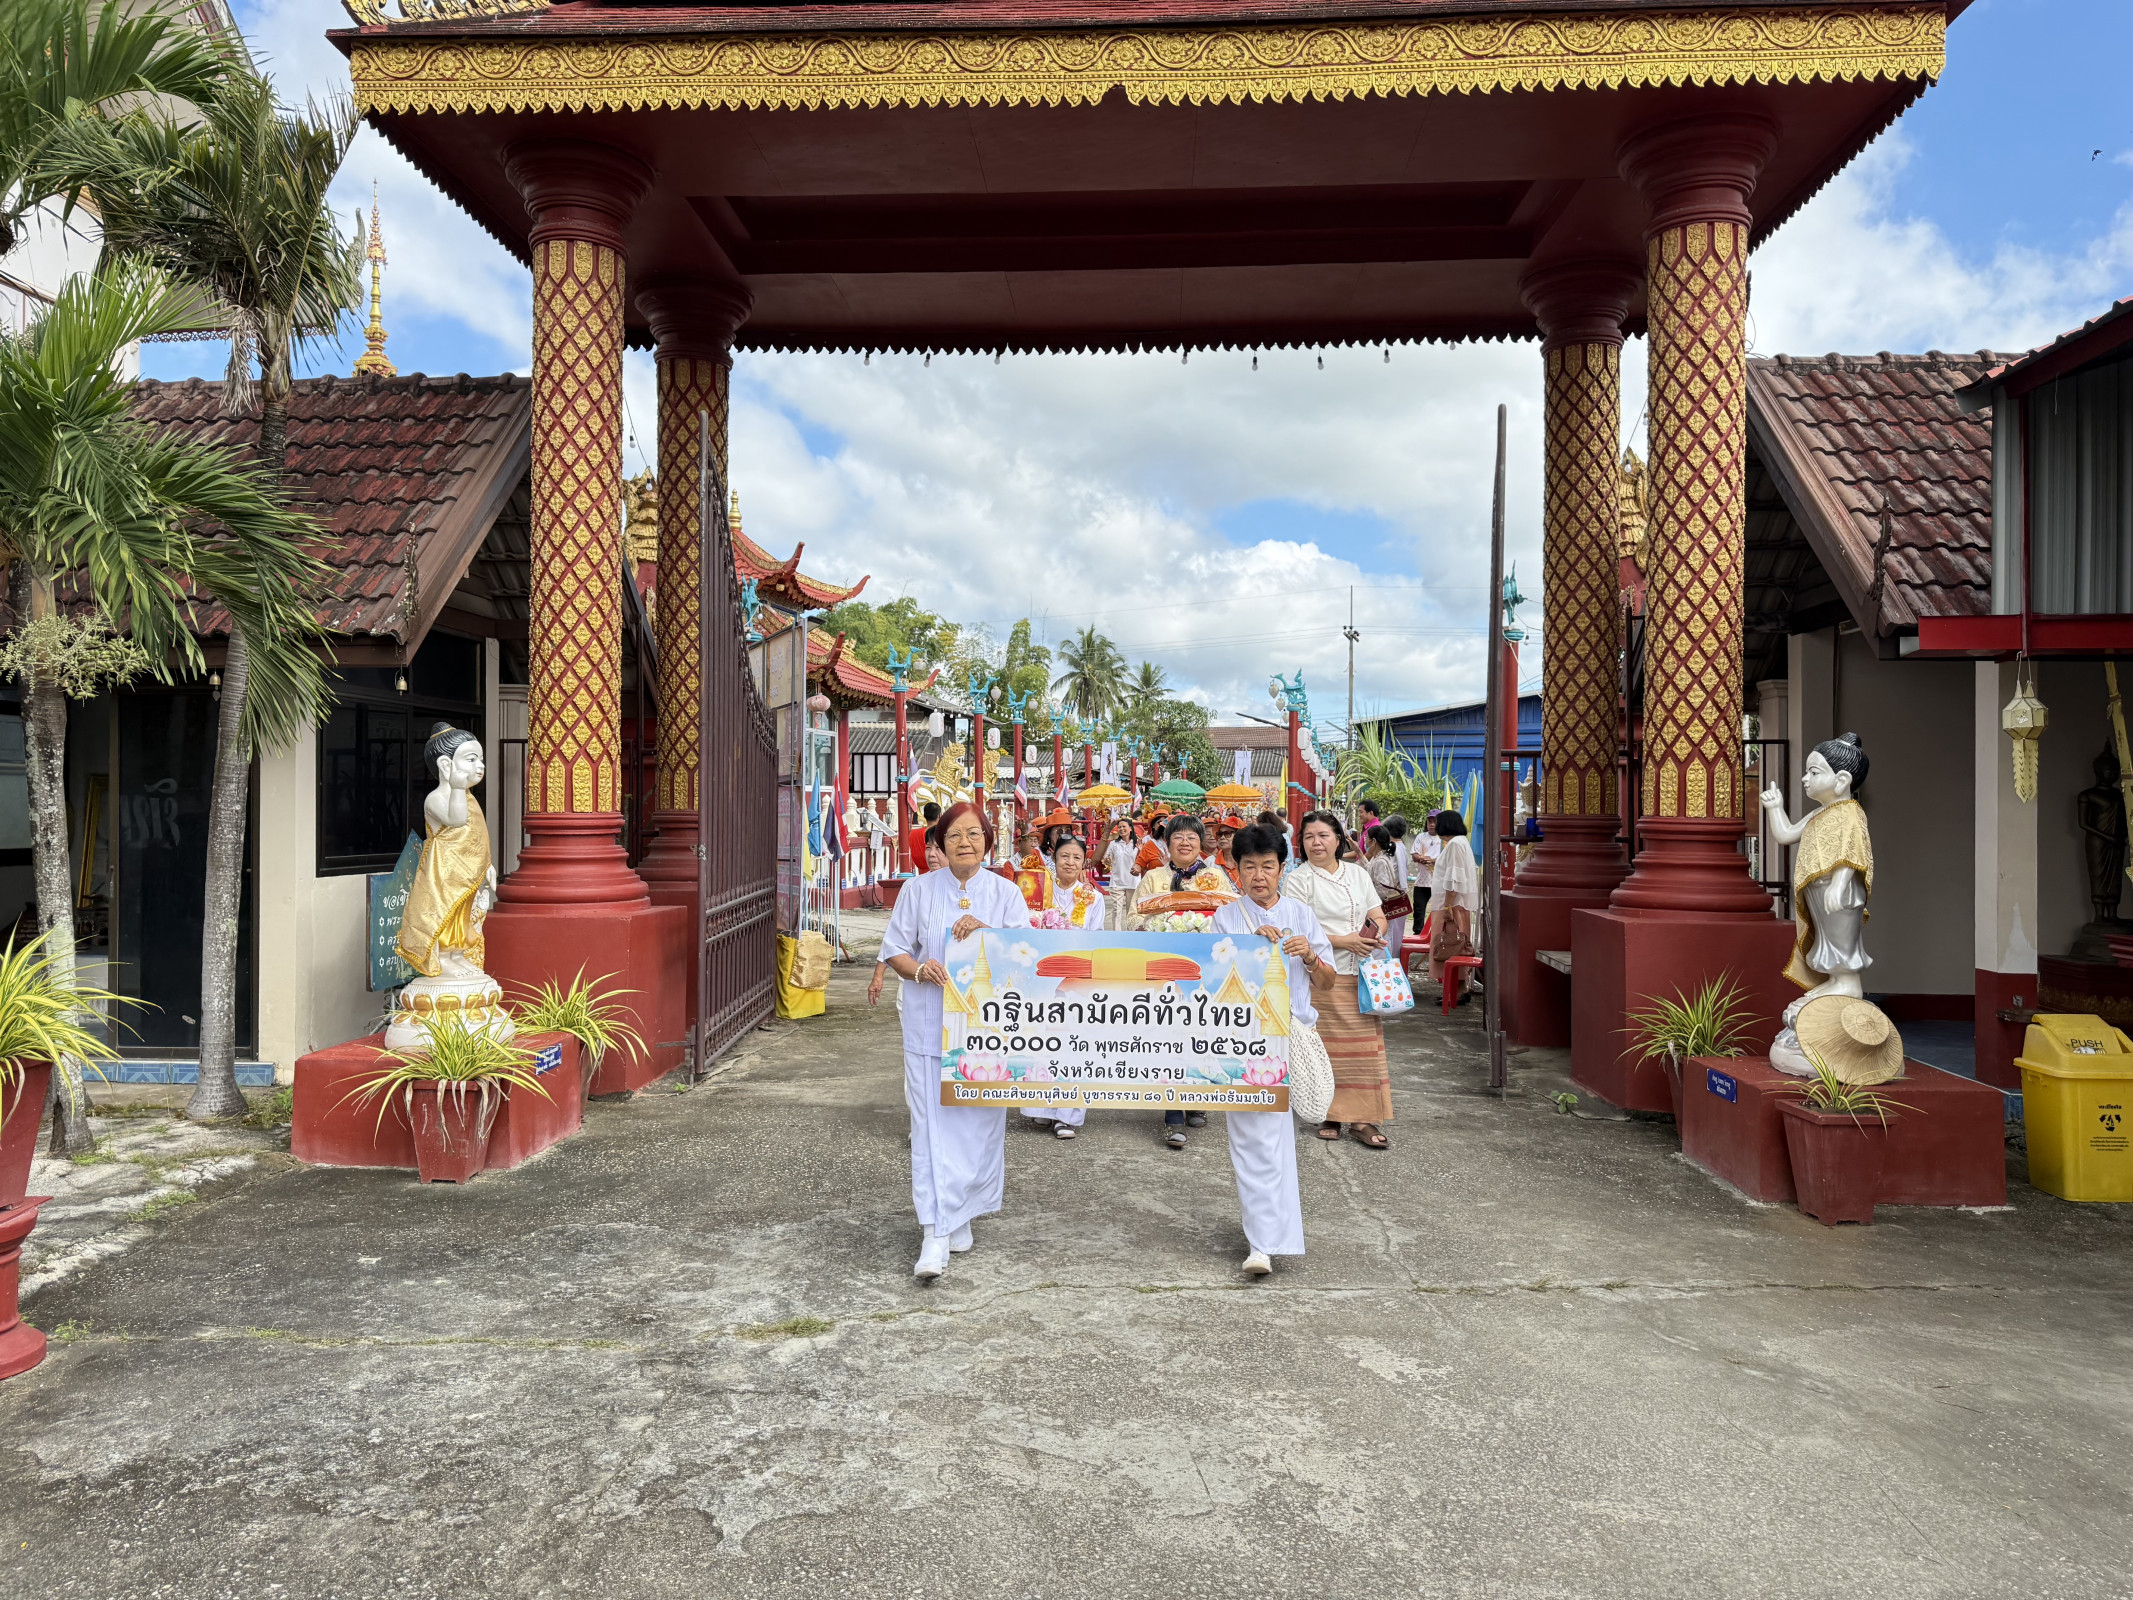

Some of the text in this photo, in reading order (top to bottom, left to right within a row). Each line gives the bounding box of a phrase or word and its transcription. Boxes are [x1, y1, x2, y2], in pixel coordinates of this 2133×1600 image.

[982, 985, 1251, 1032] กฐินสามัคคีทั่วไทย
[966, 1034, 1267, 1059] ๓๐,๐๐๐ วัด พุทธศักราช ๒๕๖๘
[2070, 1038, 2104, 1048] PUSH
[1048, 1060, 1184, 1080] จังหวัดเชียงราย
[955, 1085, 978, 1099] โดย
[982, 1086, 1078, 1102] คณะศิษยานุศิษย์
[1082, 1090, 1139, 1104] บูชาธรรม
[1165, 1088, 1175, 1102] ปี
